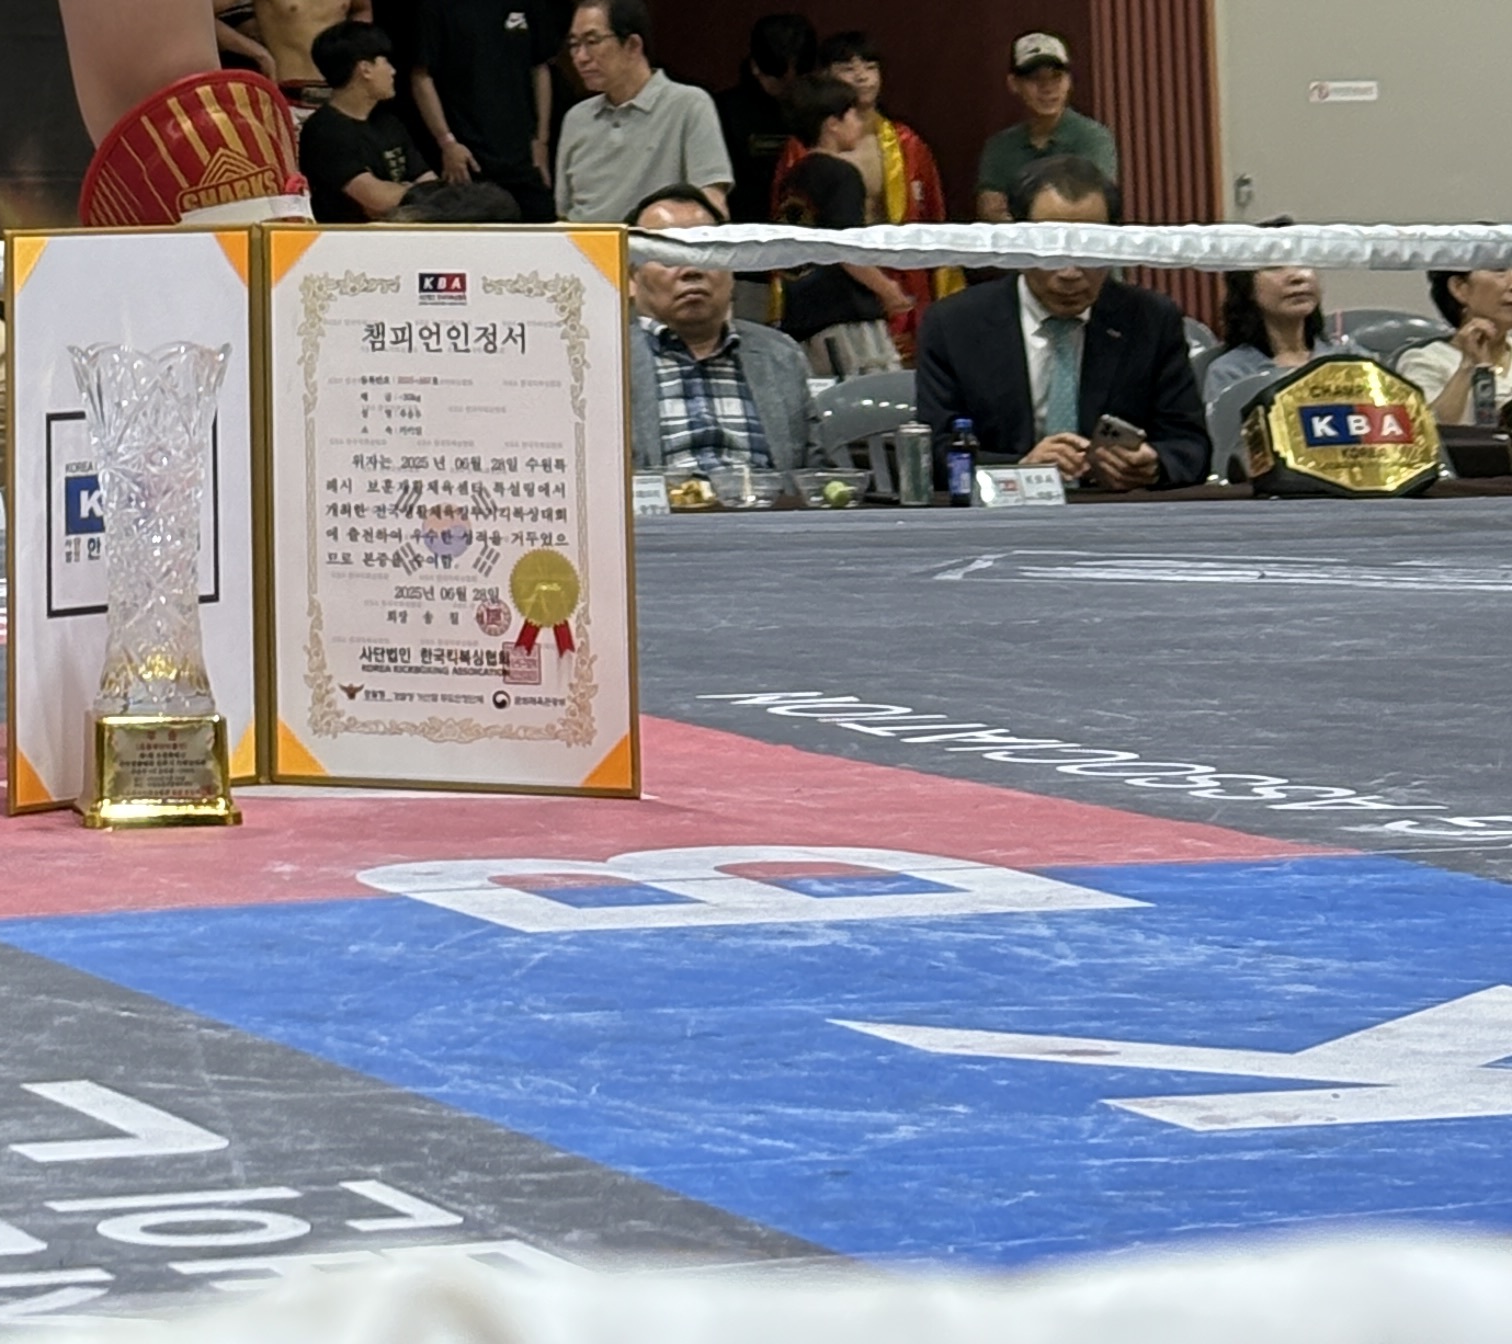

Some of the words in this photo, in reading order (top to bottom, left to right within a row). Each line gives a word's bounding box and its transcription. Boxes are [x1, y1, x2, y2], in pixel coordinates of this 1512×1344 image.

[422, 276, 462, 291] KBA
[361, 321, 527, 355] 챔피언인정서
[1310, 414, 1404, 439] KBA
[394, 585, 436, 601] 2025년
[440, 586, 468, 601] 06월
[359, 646, 412, 663] 사단법인
[419, 647, 510, 666] 한국킥복싱협회
[361, 664, 391, 674] KOREA
[695, 691, 1450, 810] ASSOCIATION
